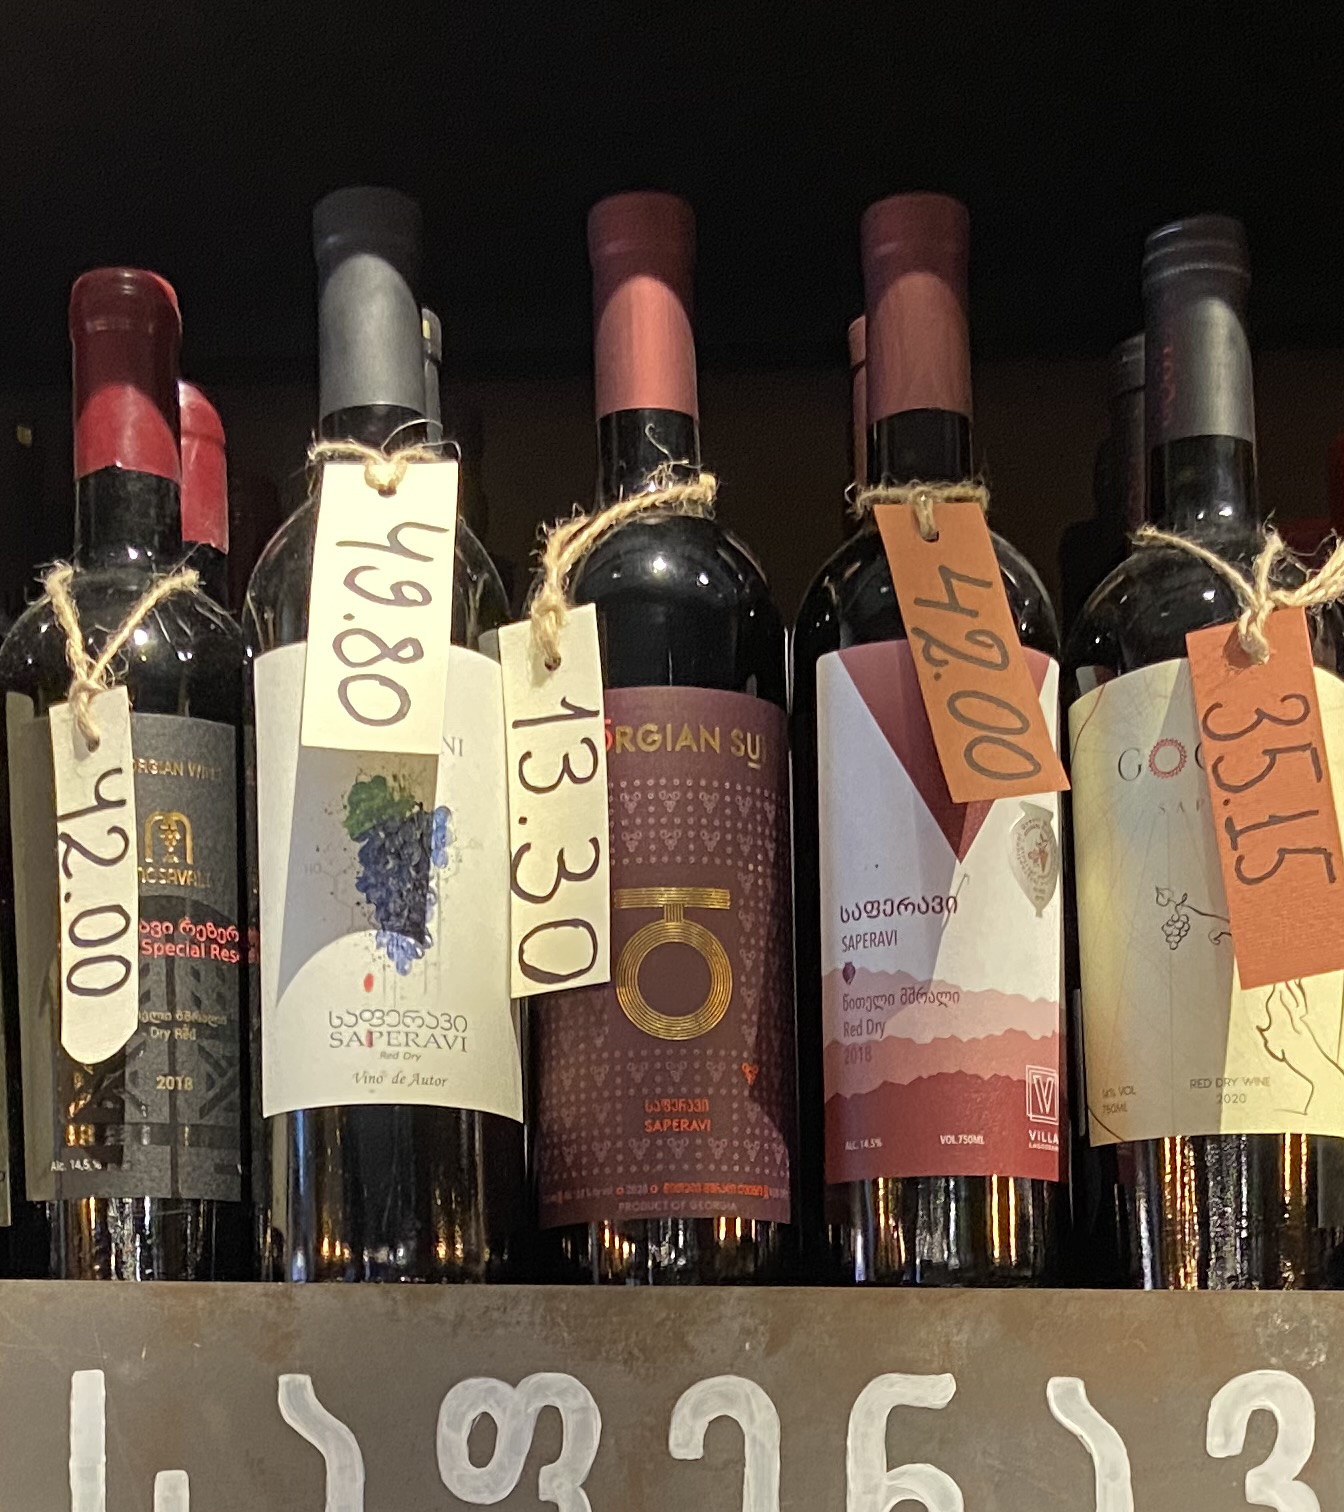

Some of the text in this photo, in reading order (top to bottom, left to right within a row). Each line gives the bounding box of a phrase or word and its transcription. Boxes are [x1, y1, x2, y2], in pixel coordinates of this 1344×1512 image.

[332, 521, 450, 727] 49.80
[911, 565, 1042, 781] 42.00
[1202, 694, 1336, 886] 35.15
[512, 697, 600, 984] 13.30
[57, 767, 131, 998] 42.00
[840, 895, 959, 924] საფერავი
[141, 941, 206, 960] Special
[841, 930, 899, 954] SAPERAVI
[843, 986, 961, 1013] წითელი მშრალი
[328, 1008, 469, 1033] საფერავი
[843, 1019, 887, 1040] Red Dry
[150, 1026, 171, 1041] Dry
[328, 1030, 468, 1053] SAPERAVI
[403, 1051, 423, 1063] Dry
[843, 1045, 874, 1066] 2018
[156, 1075, 194, 1091] 2018
[352, 1072, 449, 1089] Vino de Autor
[1118, 1085, 1136, 1096] VOL
[1189, 1076, 1271, 1090] RED DRY WINE
[1216, 1093, 1248, 1104] 2020
[644, 1119, 712, 1133] SAPERAVI
[1028, 1129, 1059, 1145] VILLA
